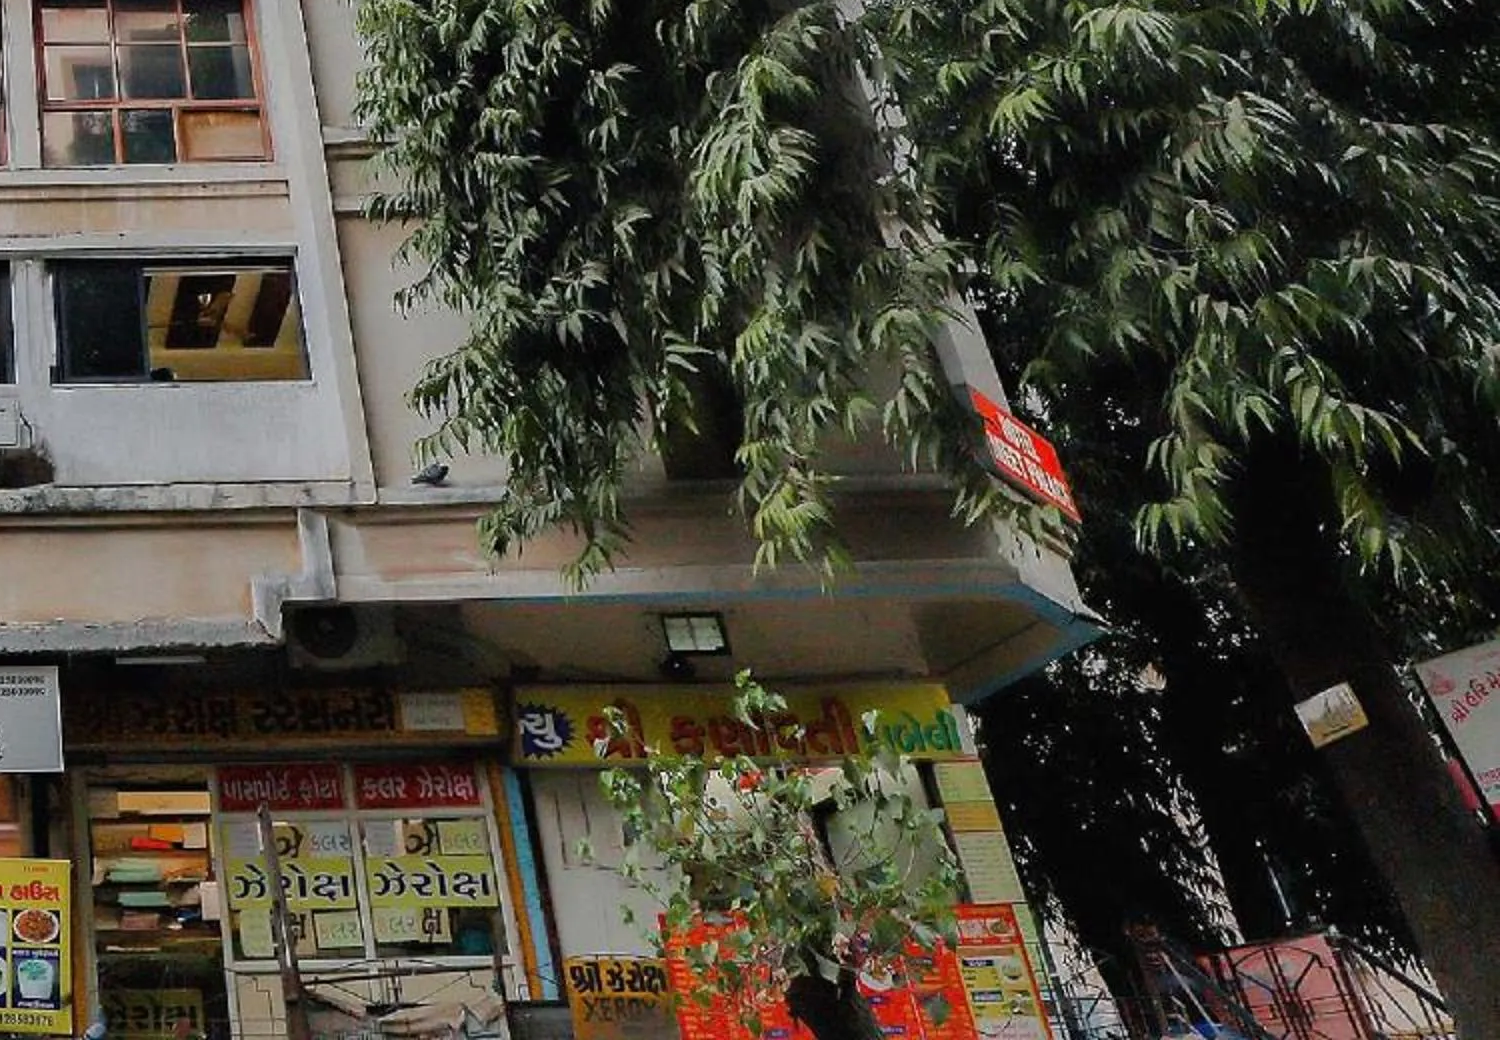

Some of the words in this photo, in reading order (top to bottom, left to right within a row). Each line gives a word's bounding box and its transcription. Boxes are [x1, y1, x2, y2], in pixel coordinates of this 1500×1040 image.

[362, 779, 406, 801] કલર
[416, 769, 475, 802] ઝેરોક્ષ
[233, 864, 350, 901] ઝેરોક્ષ
[373, 862, 490, 901] ઝેરોક્ષ
